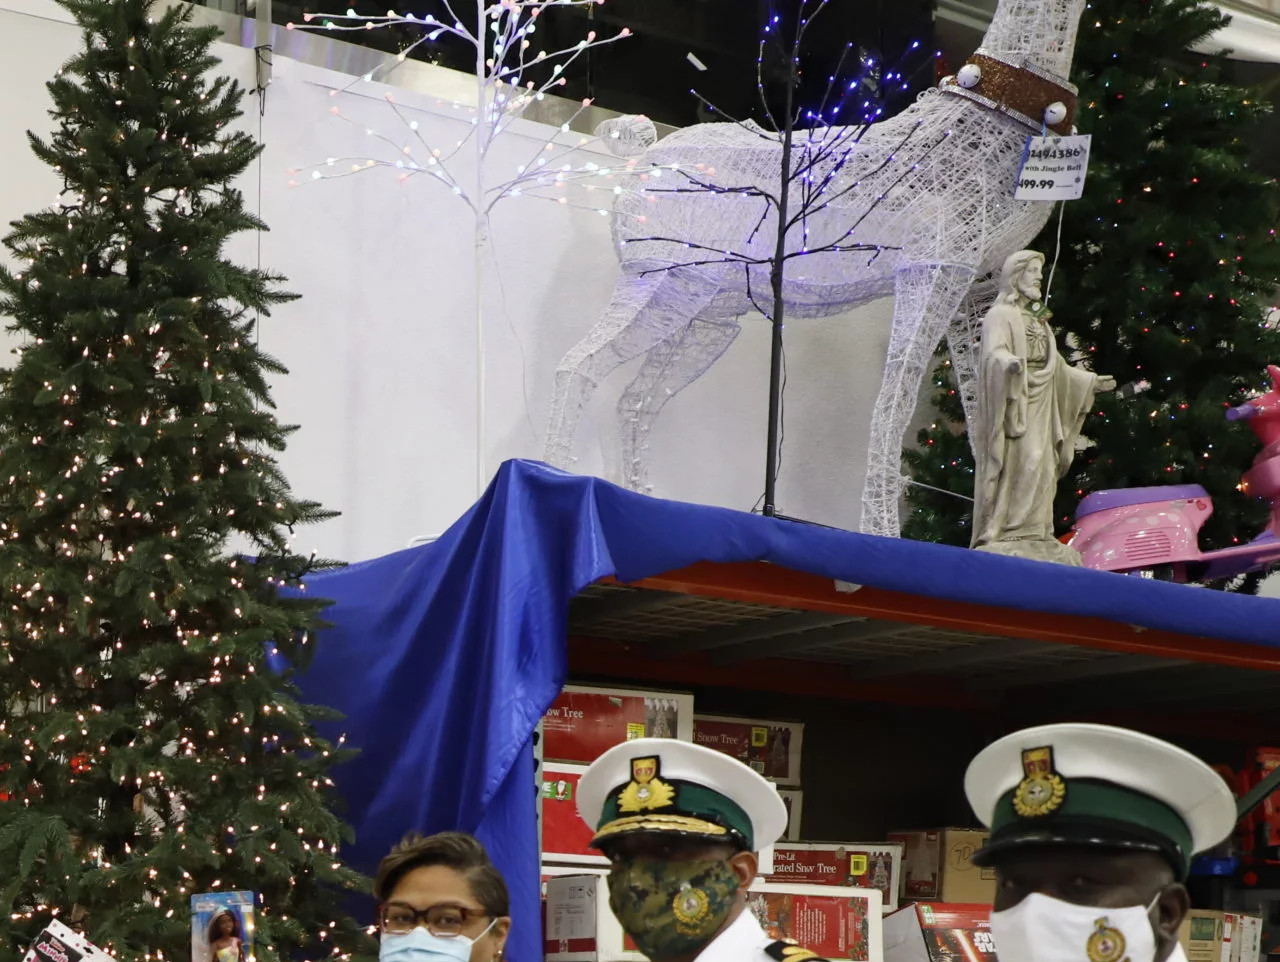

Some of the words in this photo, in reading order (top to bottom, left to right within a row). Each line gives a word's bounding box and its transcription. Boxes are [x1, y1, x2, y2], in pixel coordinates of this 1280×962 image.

[1041, 164, 1065, 173] Jingle
[562, 706, 584, 719] Tree
[697, 731, 719, 743] Snow
[721, 733, 739, 745] Tree
[773, 851, 796, 861] Pre-Lit
[817, 863, 837, 873] Tree
